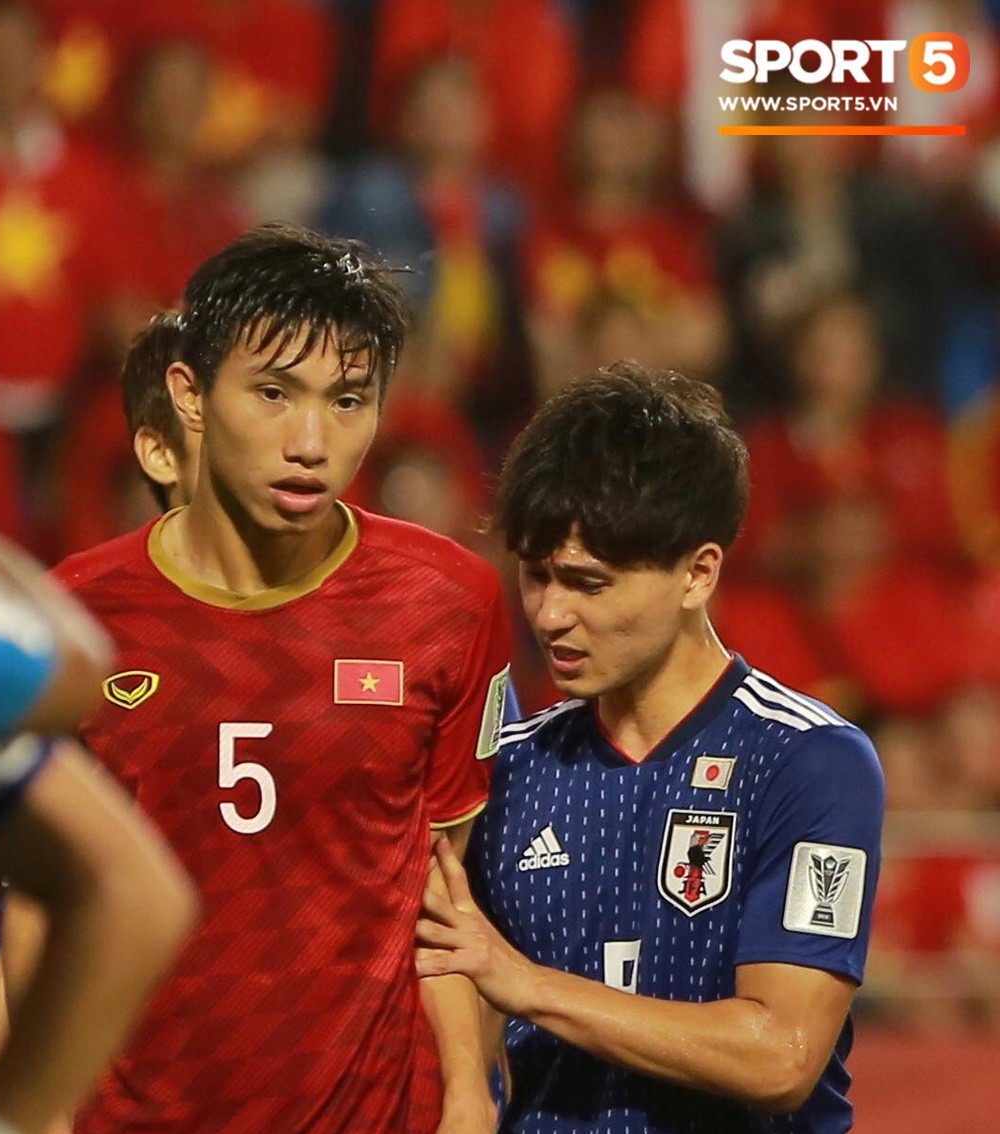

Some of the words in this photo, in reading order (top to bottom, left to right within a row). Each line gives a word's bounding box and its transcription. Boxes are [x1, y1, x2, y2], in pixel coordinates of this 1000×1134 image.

[219, 722, 277, 834] 5
[685, 815, 720, 825] JAPAN
[518, 852, 570, 872] adidas
